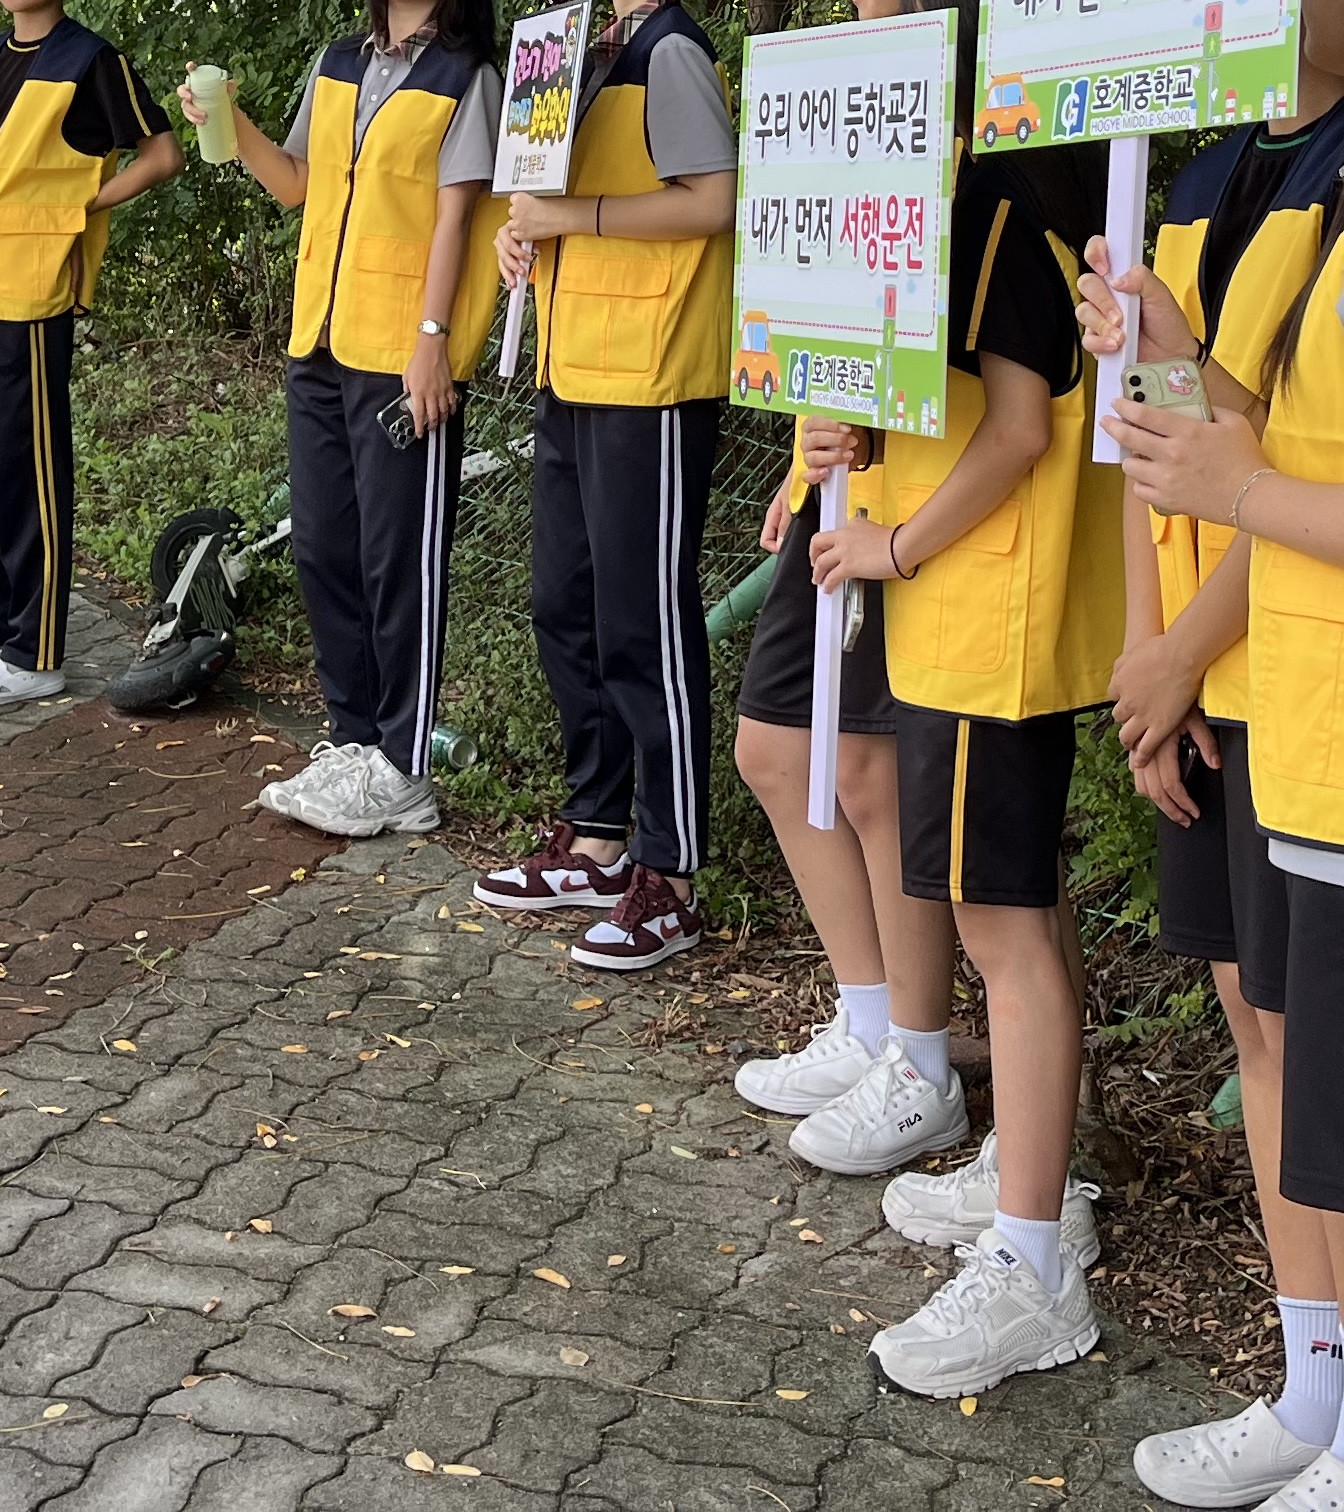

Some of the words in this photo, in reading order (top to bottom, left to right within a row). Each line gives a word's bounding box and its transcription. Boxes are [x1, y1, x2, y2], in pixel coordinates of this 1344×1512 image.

[1092, 68, 1194, 112] 호계중학교
[754, 91, 792, 159] 우리
[798, 87, 837, 148] 아이
[843, 79, 928, 159] 등하굣길
[1092, 118, 1121, 133] HOGYE
[1123, 113, 1154, 129] MIDDLE
[1157, 109, 1192, 126] SCHOOL
[751, 197, 789, 256] 내가
[795, 197, 833, 264] 먼저
[839, 193, 924, 271] 서행운전
[811, 355, 874, 393] 호계중학교
[897, 1112, 923, 1133] FILA
[995, 1248, 1017, 1265] NIKE
